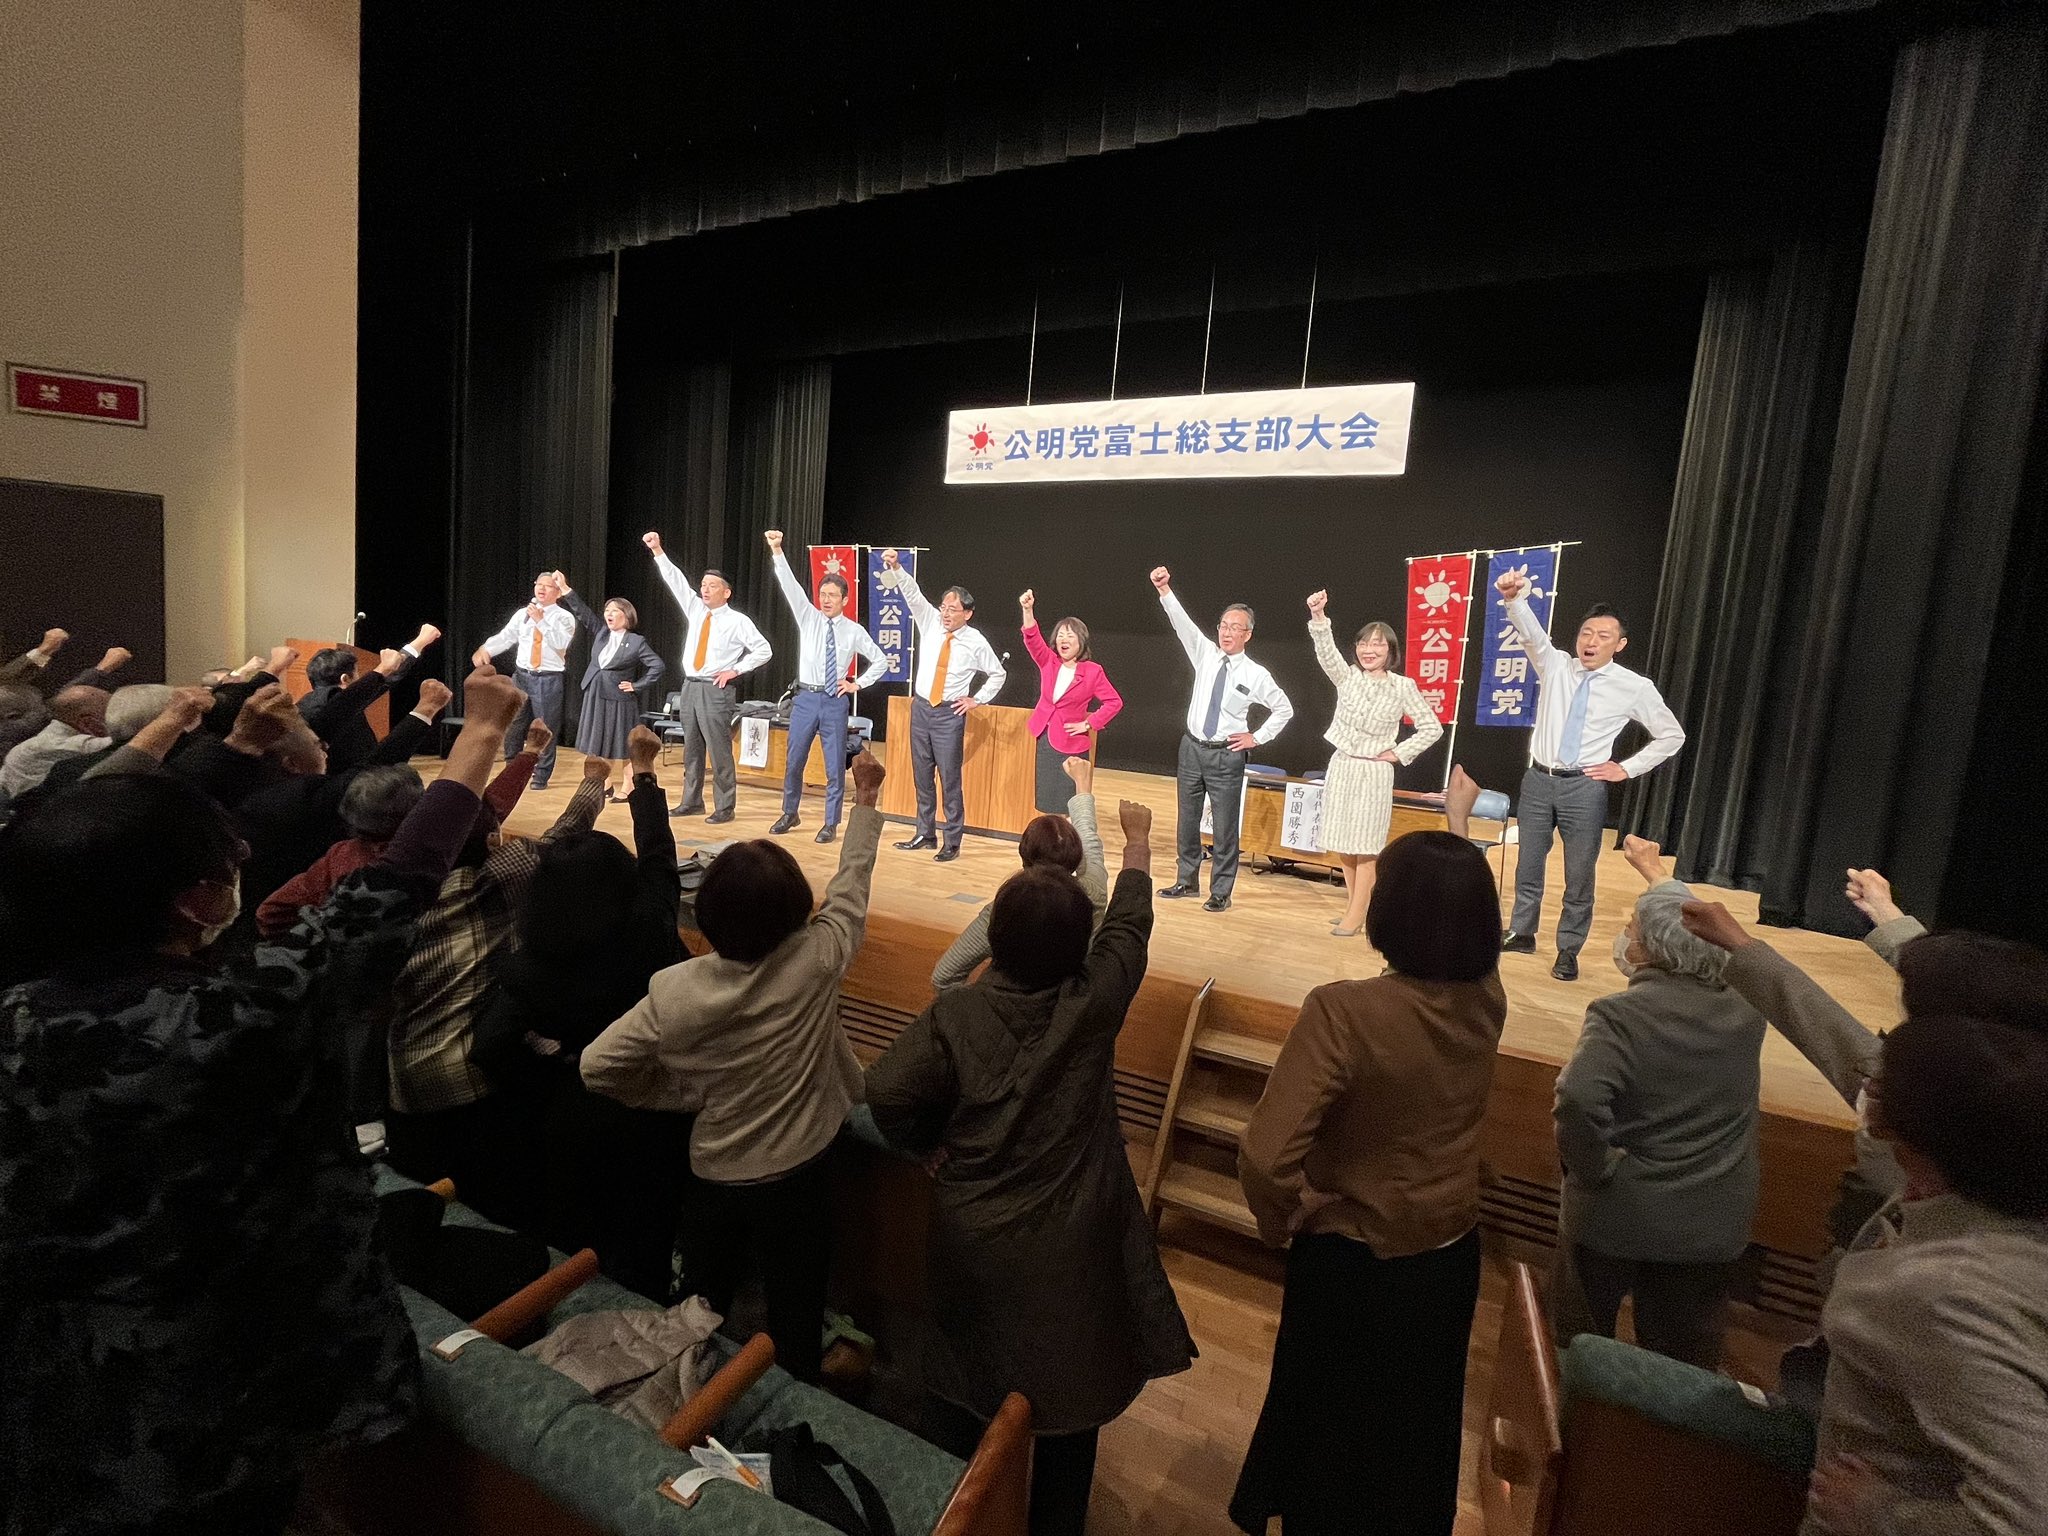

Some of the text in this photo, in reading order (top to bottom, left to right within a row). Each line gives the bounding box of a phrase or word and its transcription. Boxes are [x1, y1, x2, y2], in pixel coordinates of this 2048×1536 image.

[1003, 411, 1381, 461] 公明党富士総支部大会
[879, 605, 902, 673] 公明党
[1419, 627, 1452, 715] 公明党
[1491, 625, 1528, 714] 公明党
